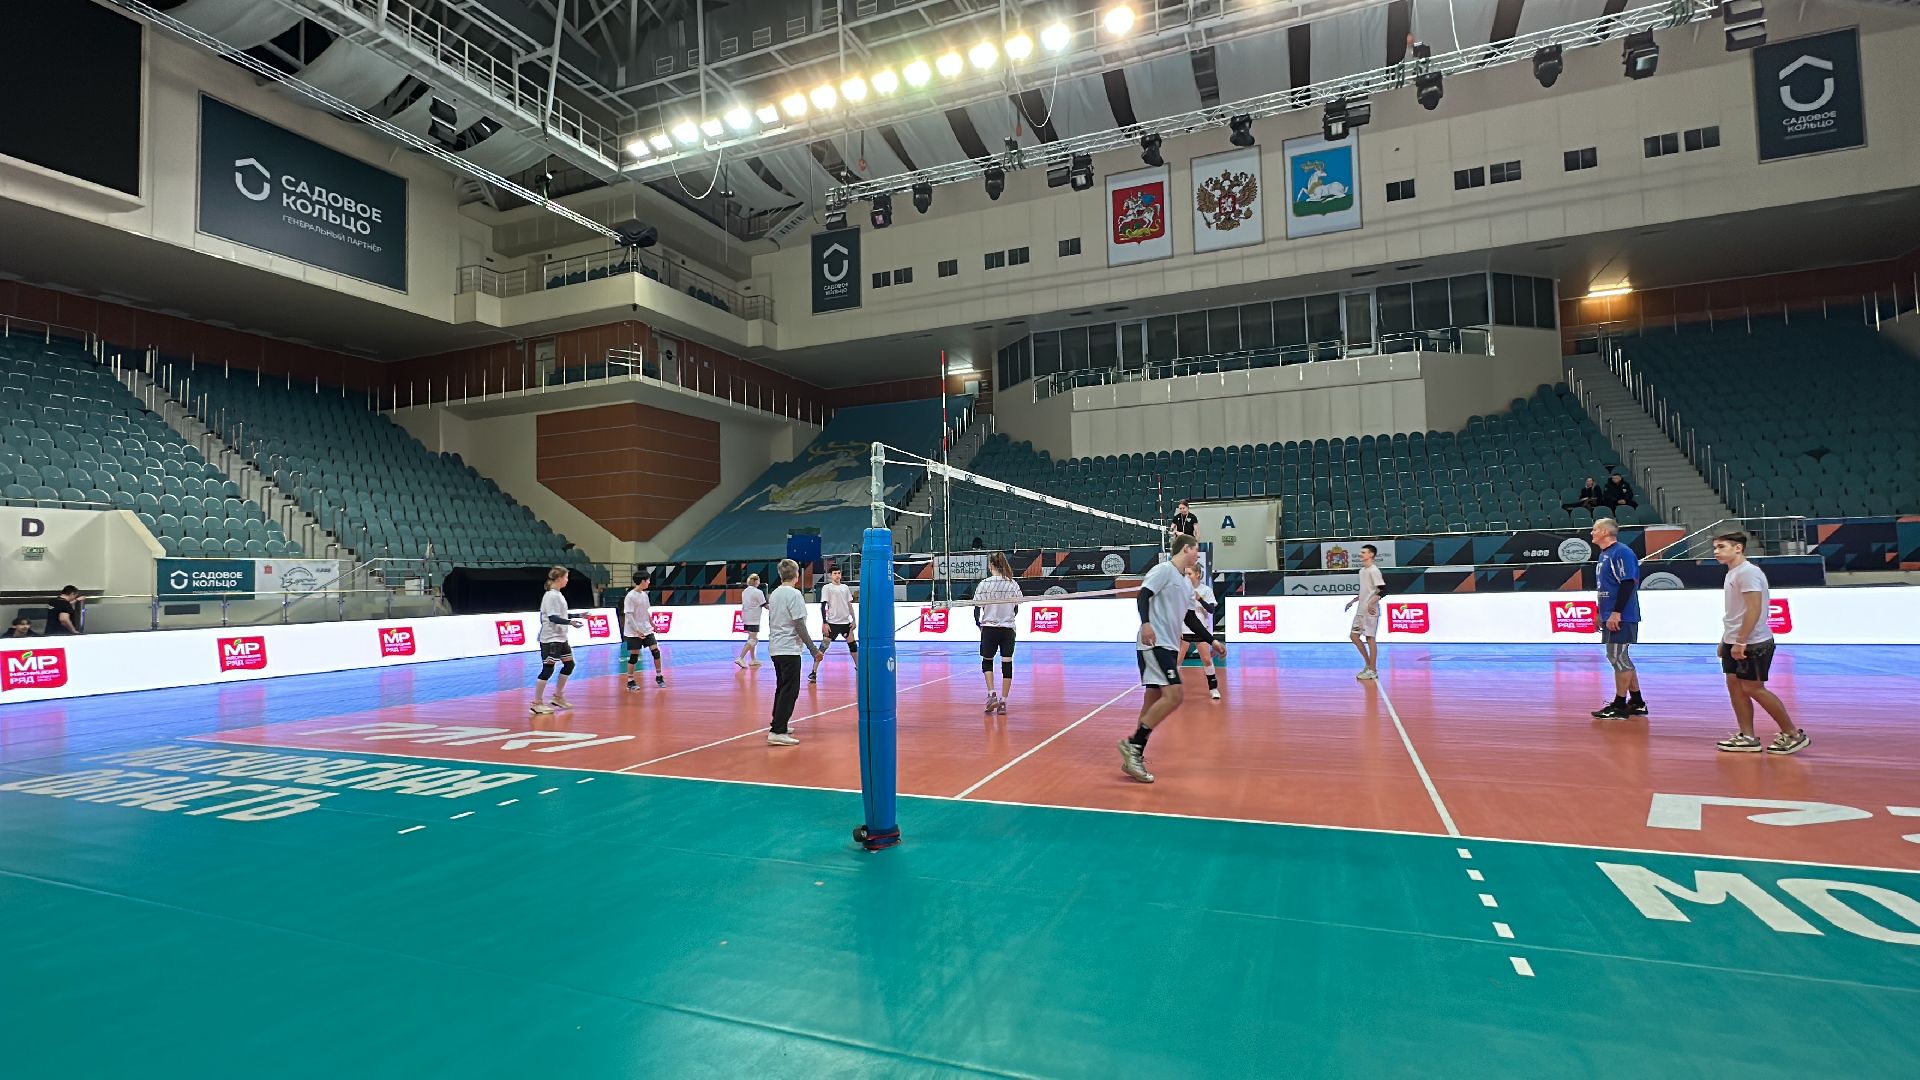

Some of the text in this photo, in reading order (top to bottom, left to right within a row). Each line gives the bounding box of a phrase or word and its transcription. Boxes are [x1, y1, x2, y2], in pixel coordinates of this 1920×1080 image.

[1783, 110, 1837, 126] САДОВОЕ
[1787, 119, 1834, 133] КОЛЬЦО
[281, 174, 382, 223] САДОВОЕ
[282, 192, 371, 235] КОЛЬЦО
[282, 214, 382, 253] ГЕНЕРАЛЬНЫЙ ПАРТНЁР
[21, 517, 45, 537] D
[192, 571, 243, 580] САДОВОЕ
[192, 579, 238, 589] КОЛЬЦО
[1313, 584, 1361, 593] САДОВО
